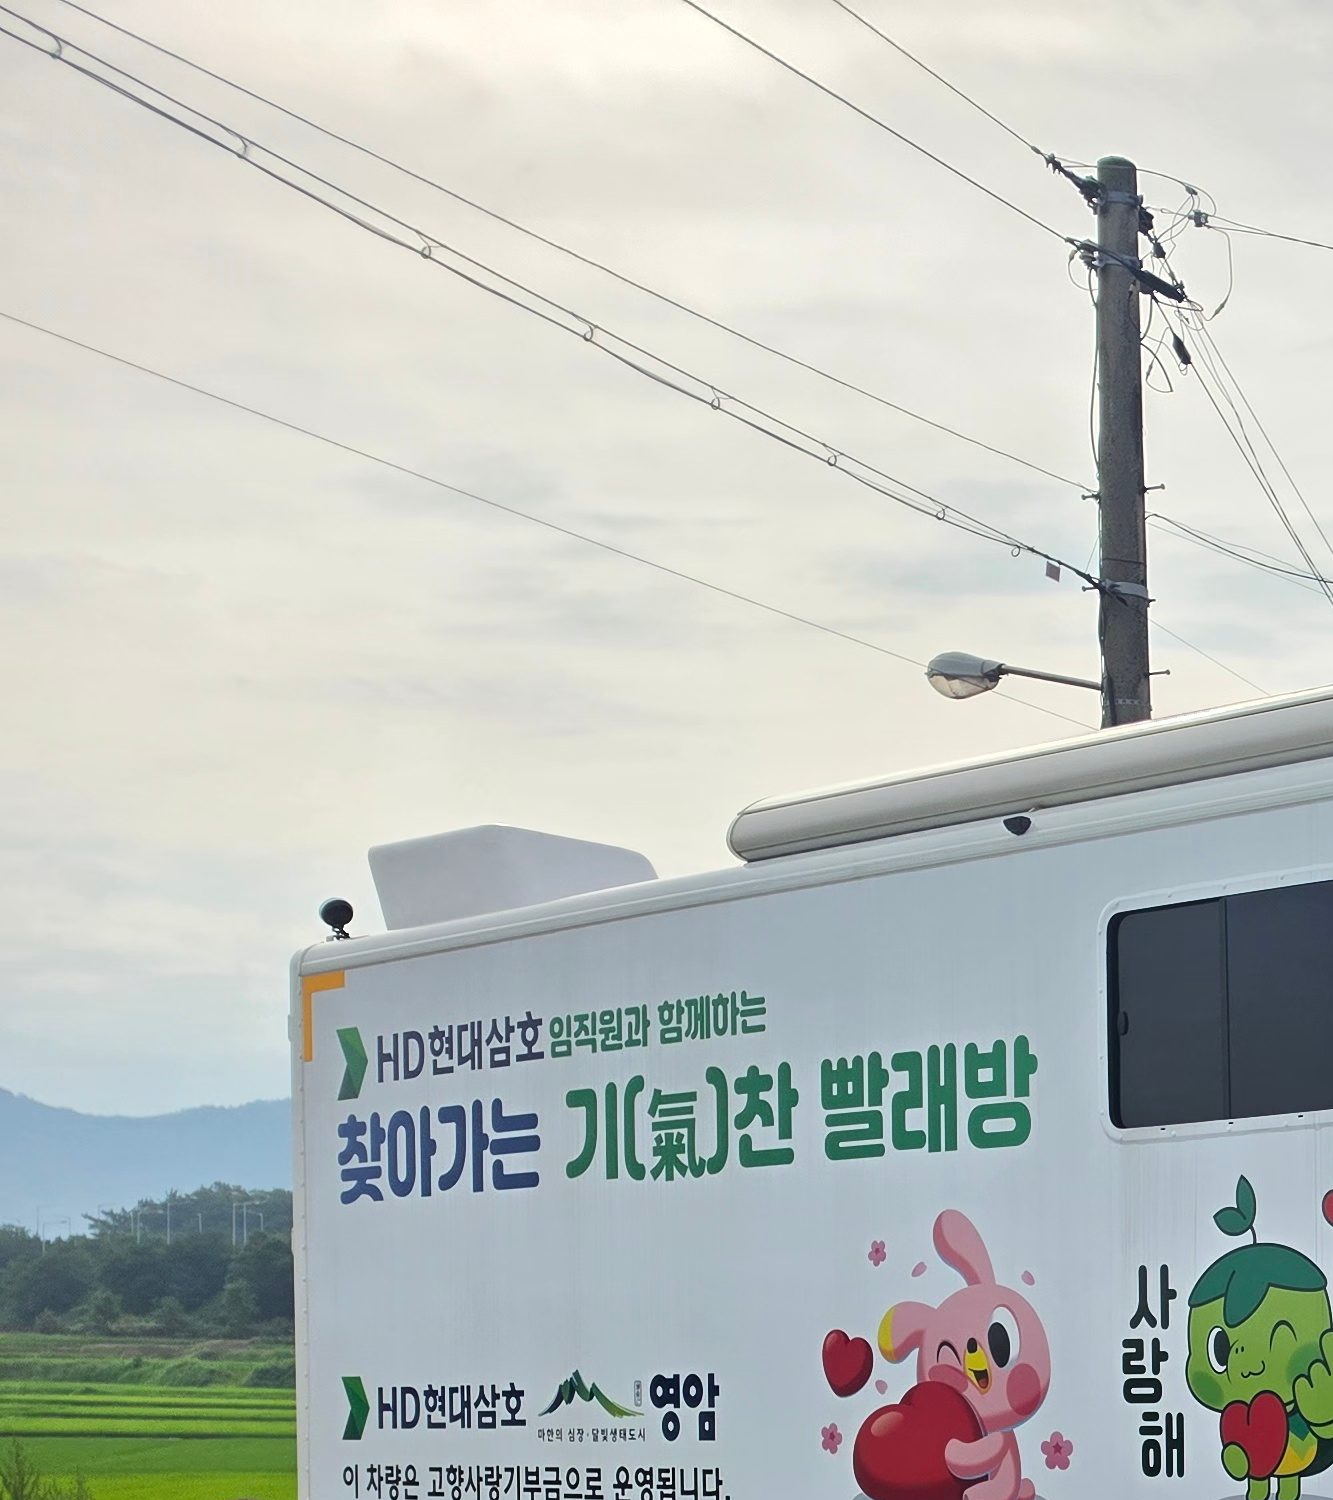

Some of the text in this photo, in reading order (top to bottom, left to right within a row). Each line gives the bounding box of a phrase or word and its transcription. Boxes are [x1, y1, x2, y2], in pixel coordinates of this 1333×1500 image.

[549, 1003, 651, 1059] 임직원과
[657, 989, 767, 1044] 함께하는
[336, 1033, 1039, 1205] 찾아가는 기(氣)찬 빨래방
[1121, 1263, 1185, 1479] 사랑해
[649, 1372, 720, 1443] 영암
[342, 1463, 359, 1499] 이
